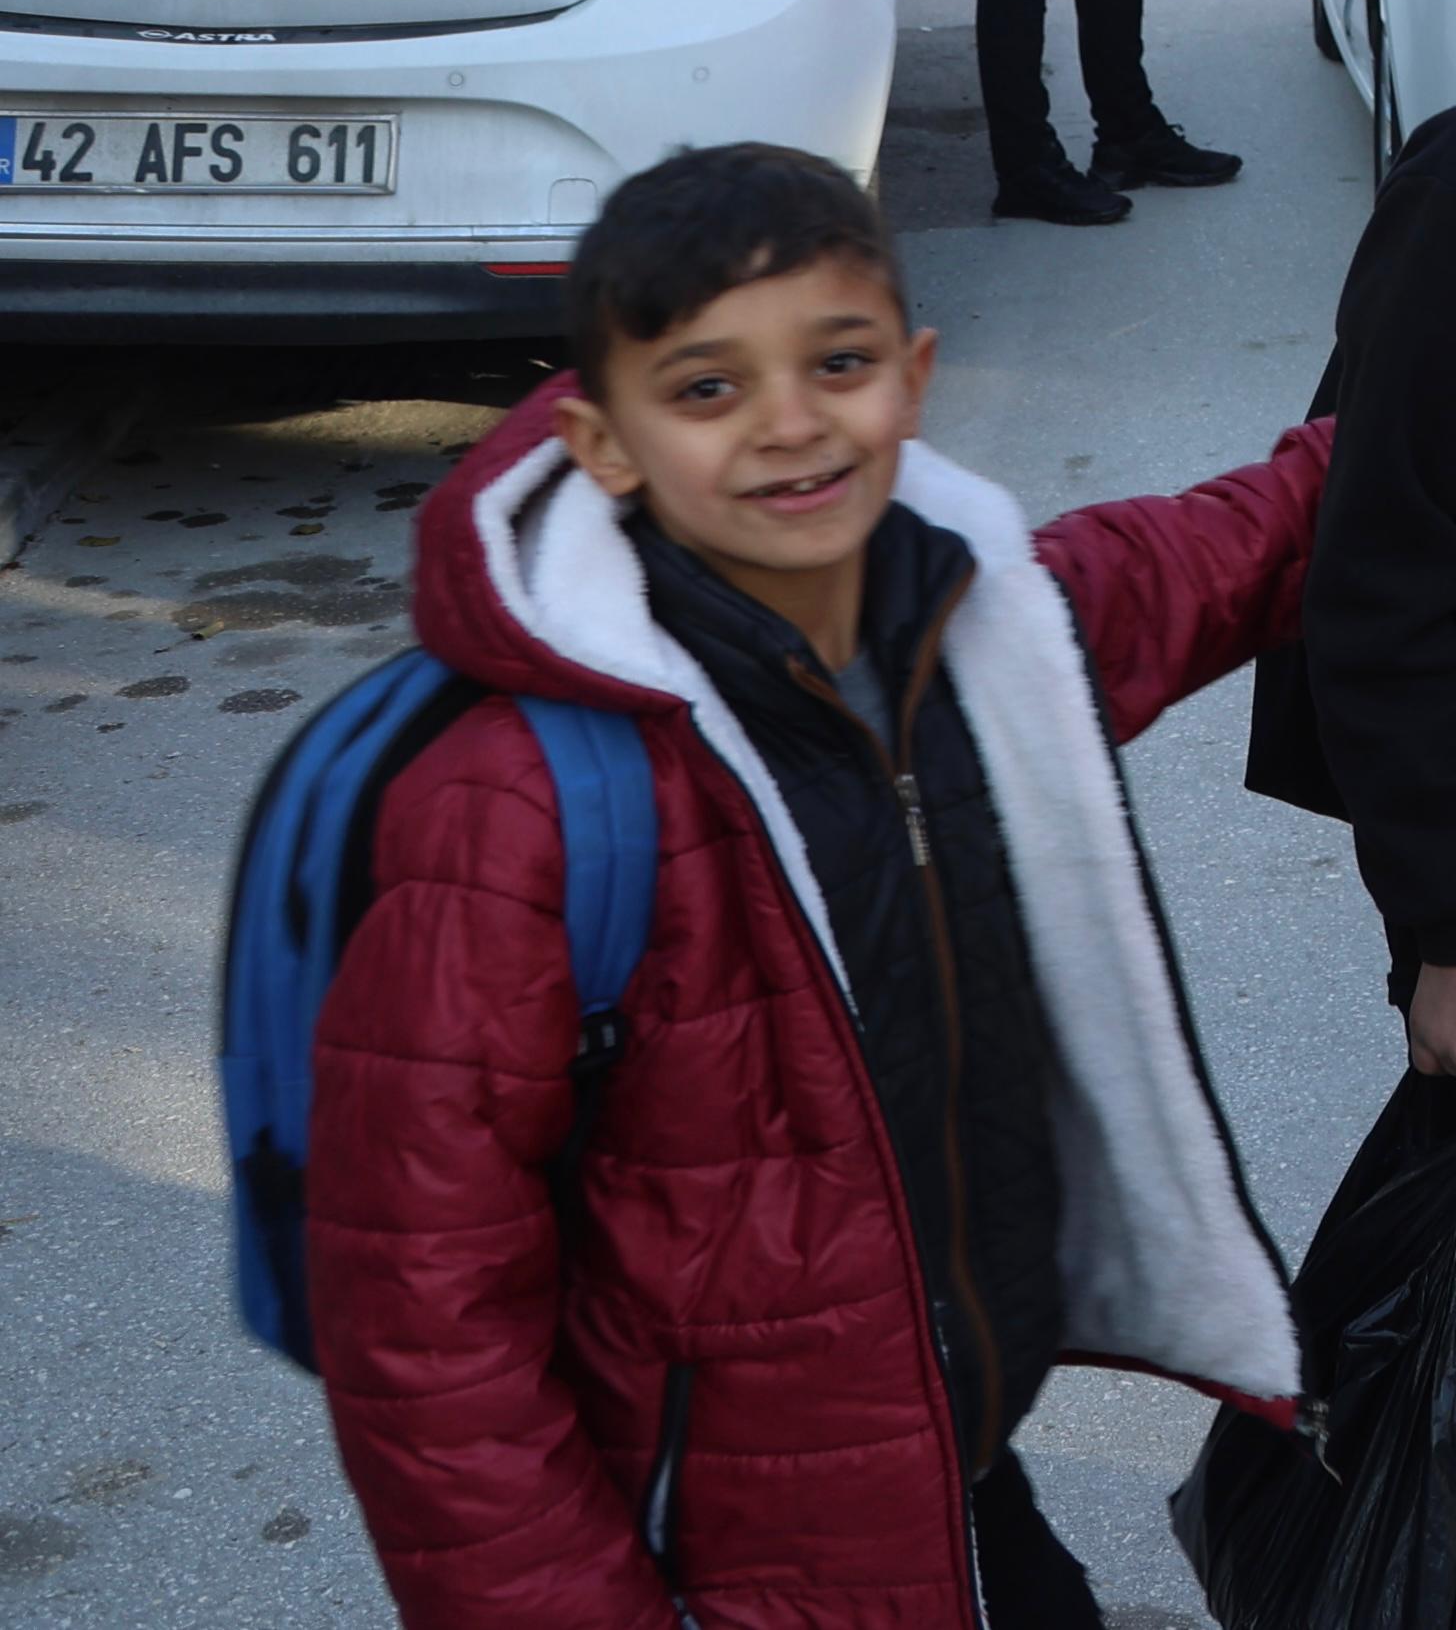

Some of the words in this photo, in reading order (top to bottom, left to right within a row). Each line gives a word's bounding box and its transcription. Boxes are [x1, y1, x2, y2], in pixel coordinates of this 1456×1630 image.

[172, 32, 277, 43] ASTRA
[21, 121, 96, 184] 42
[135, 122, 245, 184] AFS
[287, 124, 377, 184] 611
